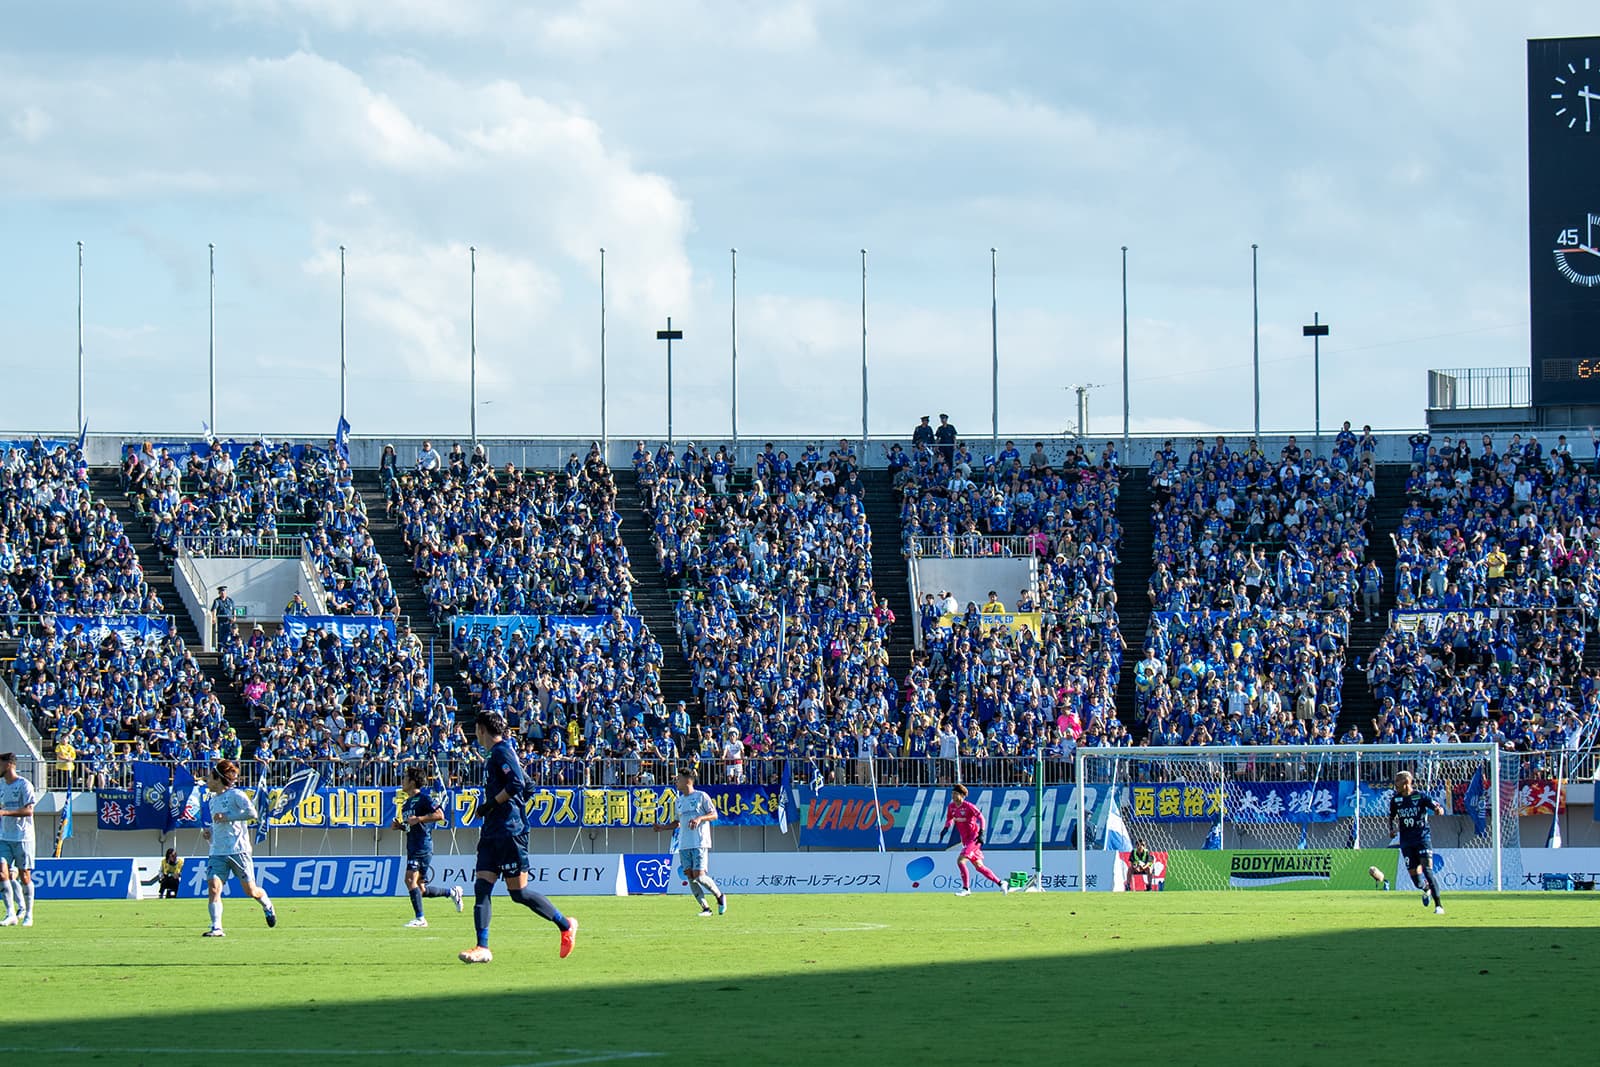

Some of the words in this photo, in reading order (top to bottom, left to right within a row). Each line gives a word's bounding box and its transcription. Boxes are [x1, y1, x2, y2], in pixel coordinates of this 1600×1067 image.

[1557, 230, 1578, 246] 45
[806, 799, 899, 831] VAMOS
[1404, 818, 1414, 827] 99
[1231, 854, 1331, 872] BODYMAINTÉ
[32, 869, 123, 887] SWEAT
[558, 867, 605, 882] CITY
[756, 874, 881, 887] 大塚ホールディングス
